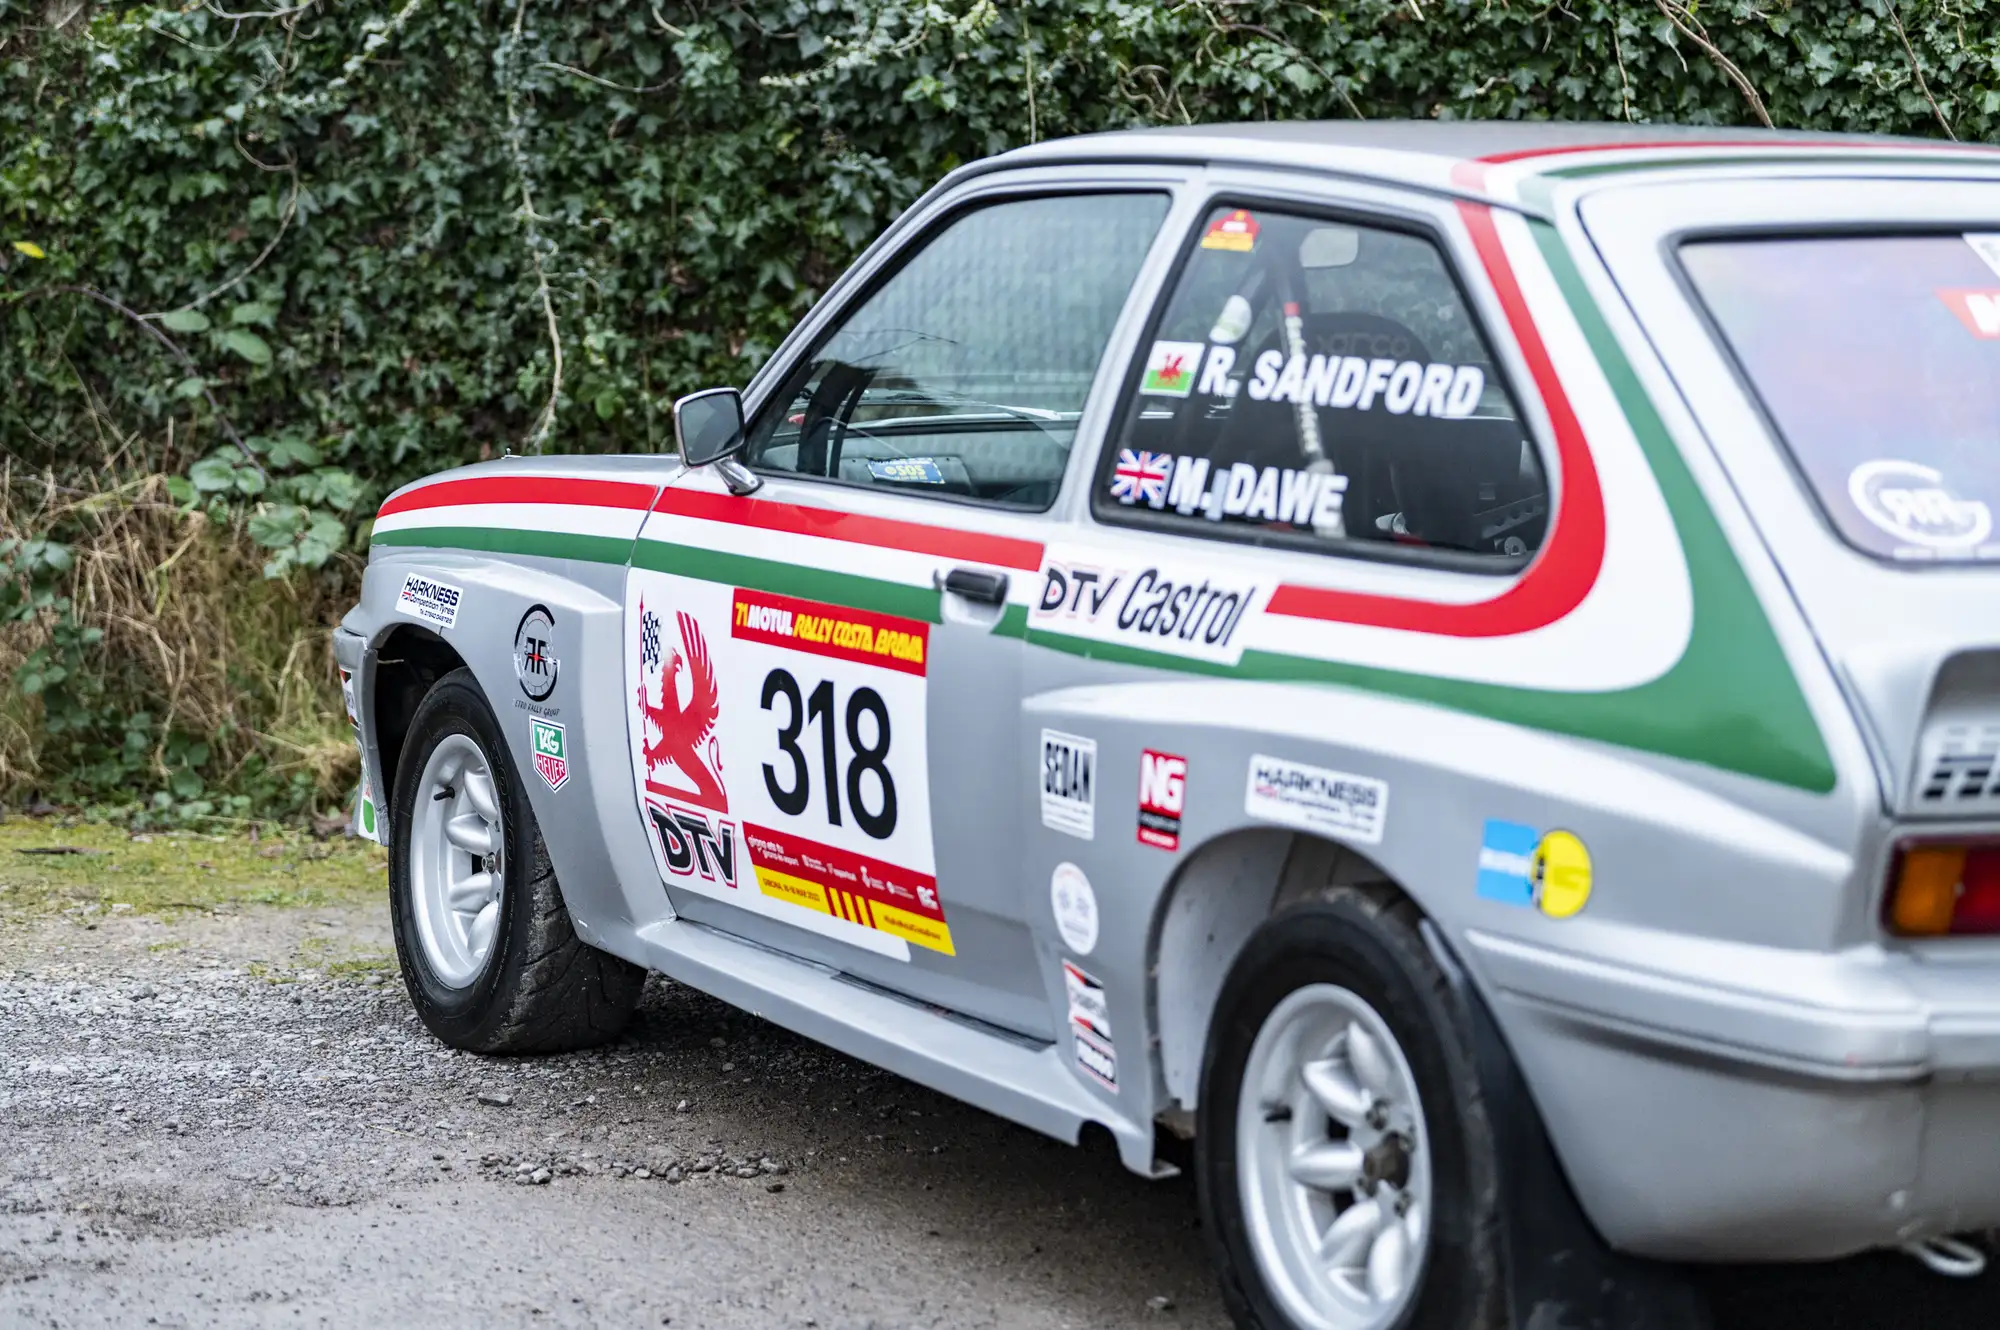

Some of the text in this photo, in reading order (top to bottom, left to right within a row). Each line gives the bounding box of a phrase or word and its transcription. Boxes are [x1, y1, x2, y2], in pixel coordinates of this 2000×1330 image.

[1197, 345, 1485, 419] R. SANDFORD
[1168, 455, 1349, 528] M. DAWE
[404, 577, 460, 607] HARKNESS
[409, 593, 439, 612] Competition
[439, 603, 455, 615] Tyres
[1037, 562, 1256, 647] DTV Castrol
[747, 604, 793, 637] MOTUL
[793, 614, 834, 645] RALLY
[832, 620, 873, 653] COSTA
[874, 628, 924, 664] BRAVA
[527, 703, 543, 714] RALLY
[537, 726, 560, 754] TAG
[760, 667, 898, 841] 318
[536, 756, 567, 785] HEUER
[1140, 752, 1187, 813] NG
[645, 798, 737, 889] DTV
